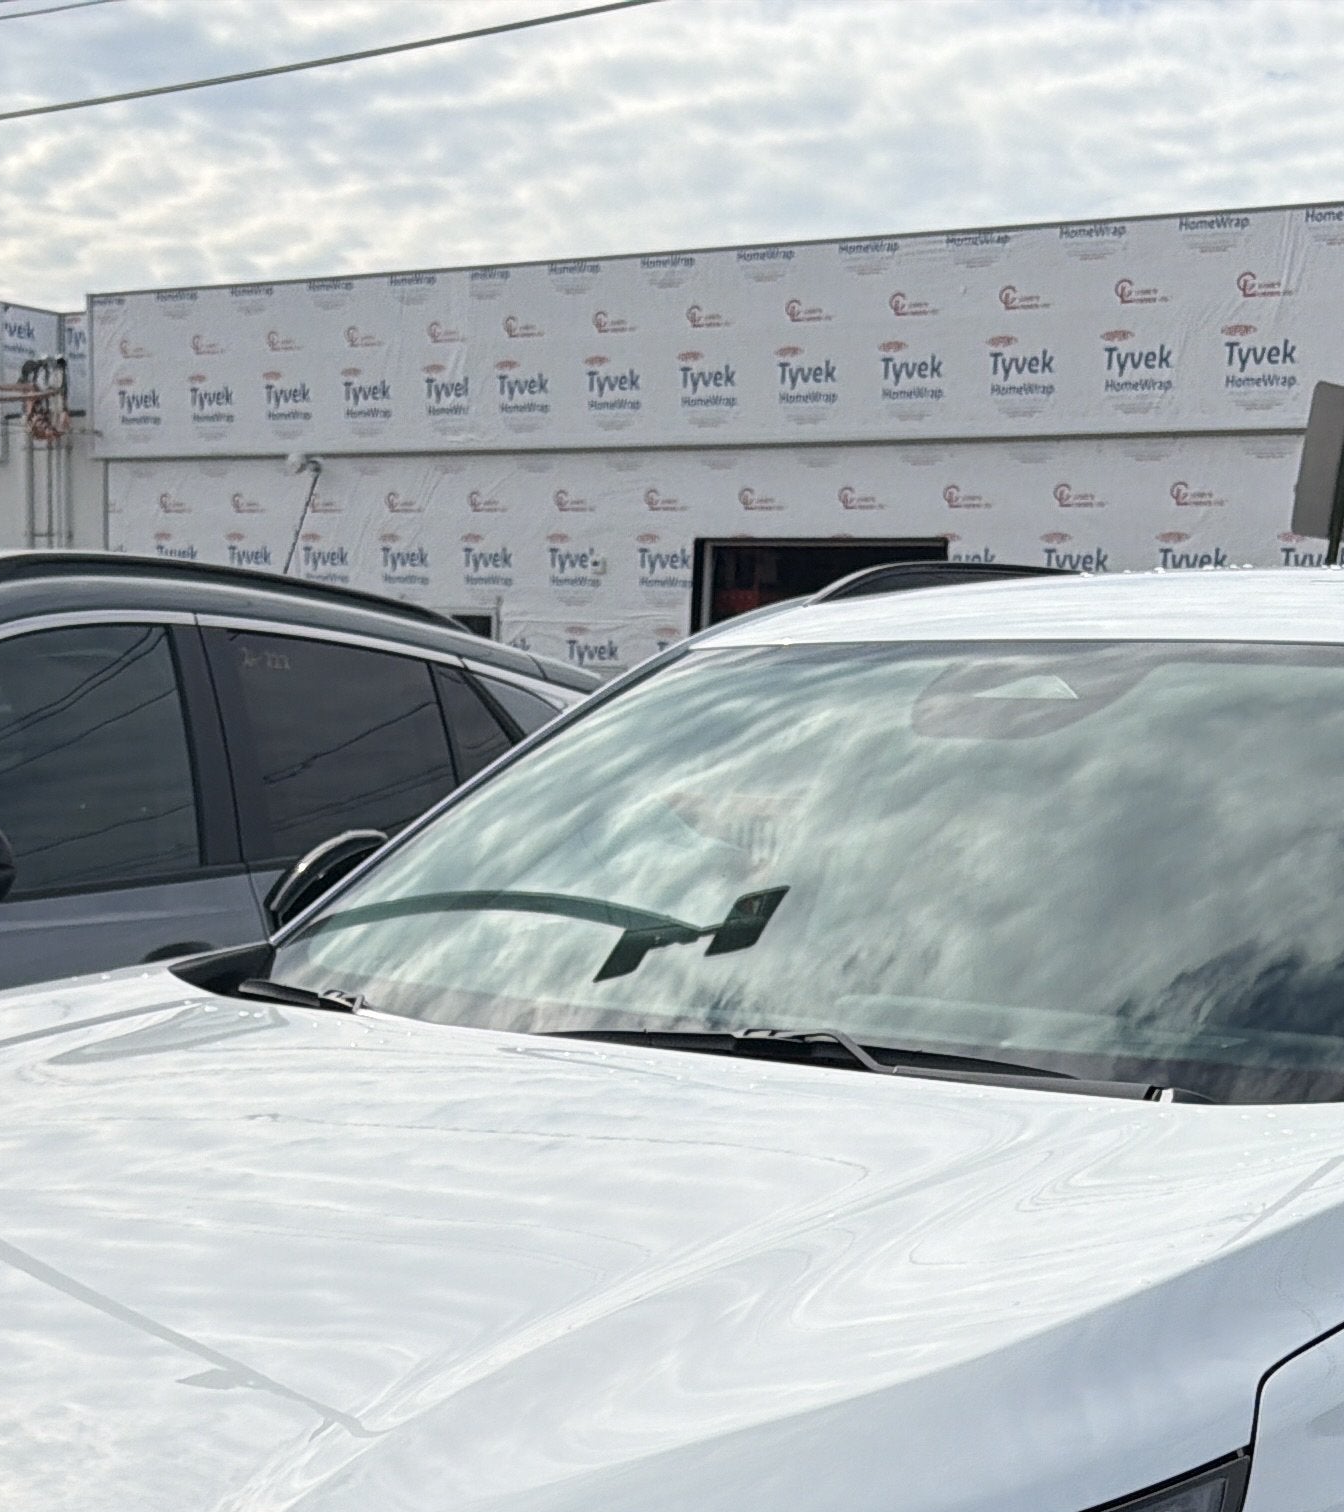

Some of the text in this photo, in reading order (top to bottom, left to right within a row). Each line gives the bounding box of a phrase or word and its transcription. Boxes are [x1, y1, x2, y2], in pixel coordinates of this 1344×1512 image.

[881, 354, 942, 385] Tyvek
[990, 349, 1054, 381] Tyvek
[1105, 343, 1172, 376] Tyvek
[1225, 339, 1296, 372] Tyvek
[498, 374, 548, 400] Tyvek
[587, 369, 640, 397] Tyvek
[681, 365, 736, 394] Tyvek
[778, 360, 836, 389] Tyvek
[463, 547, 512, 573] Tyvek
